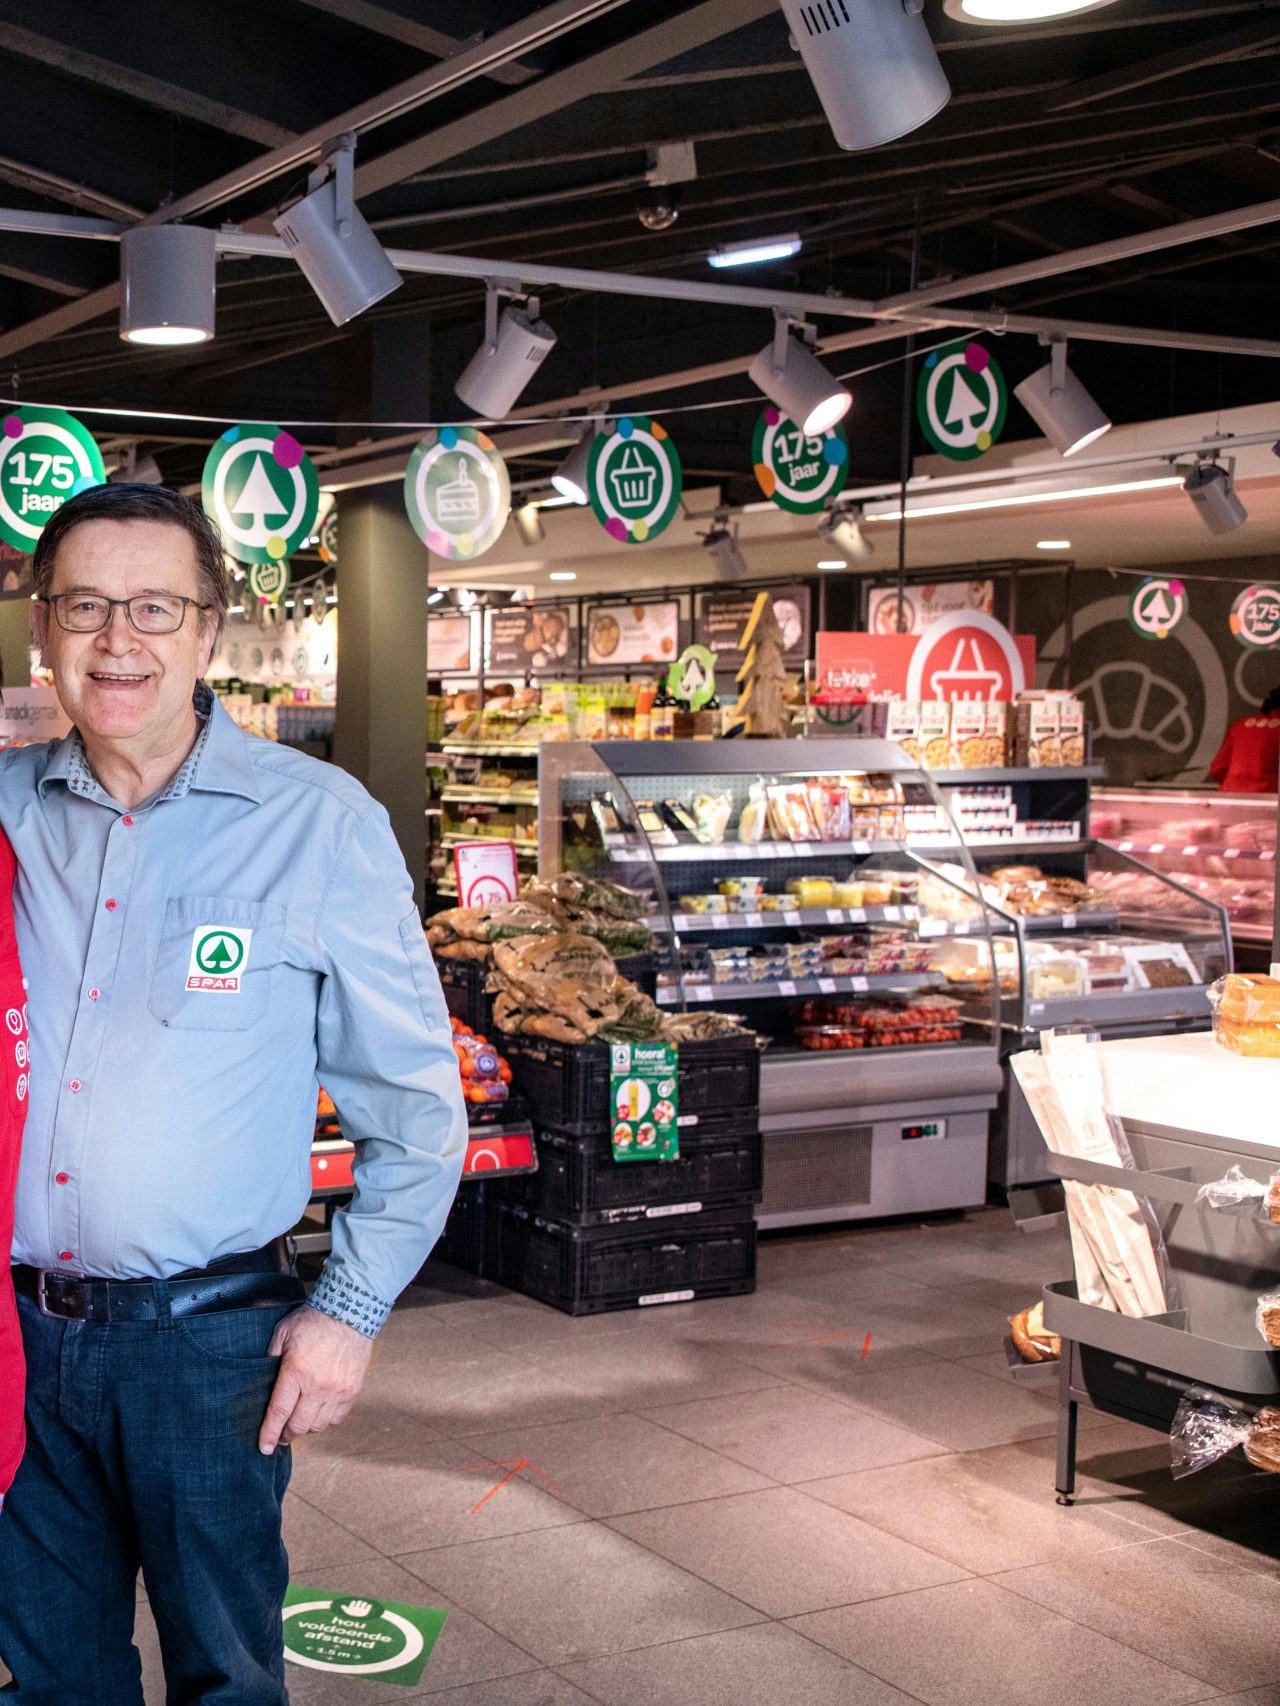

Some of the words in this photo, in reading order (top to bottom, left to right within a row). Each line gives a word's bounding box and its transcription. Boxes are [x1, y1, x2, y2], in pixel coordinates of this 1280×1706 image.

[774, 431, 824, 464] 175
[8, 452, 74, 489] 175
[788, 461, 820, 487] jaar
[19, 488, 65, 515] jaar
[1247, 602, 1280, 621] 175
[190, 977, 237, 989] SPAR
[634, 1047, 666, 1060] hoera!
[298, 1620, 393, 1643] voldoende
[331, 1616, 367, 1629] hou
[304, 1631, 376, 1649] afstand
[337, 1650, 351, 1658] m
